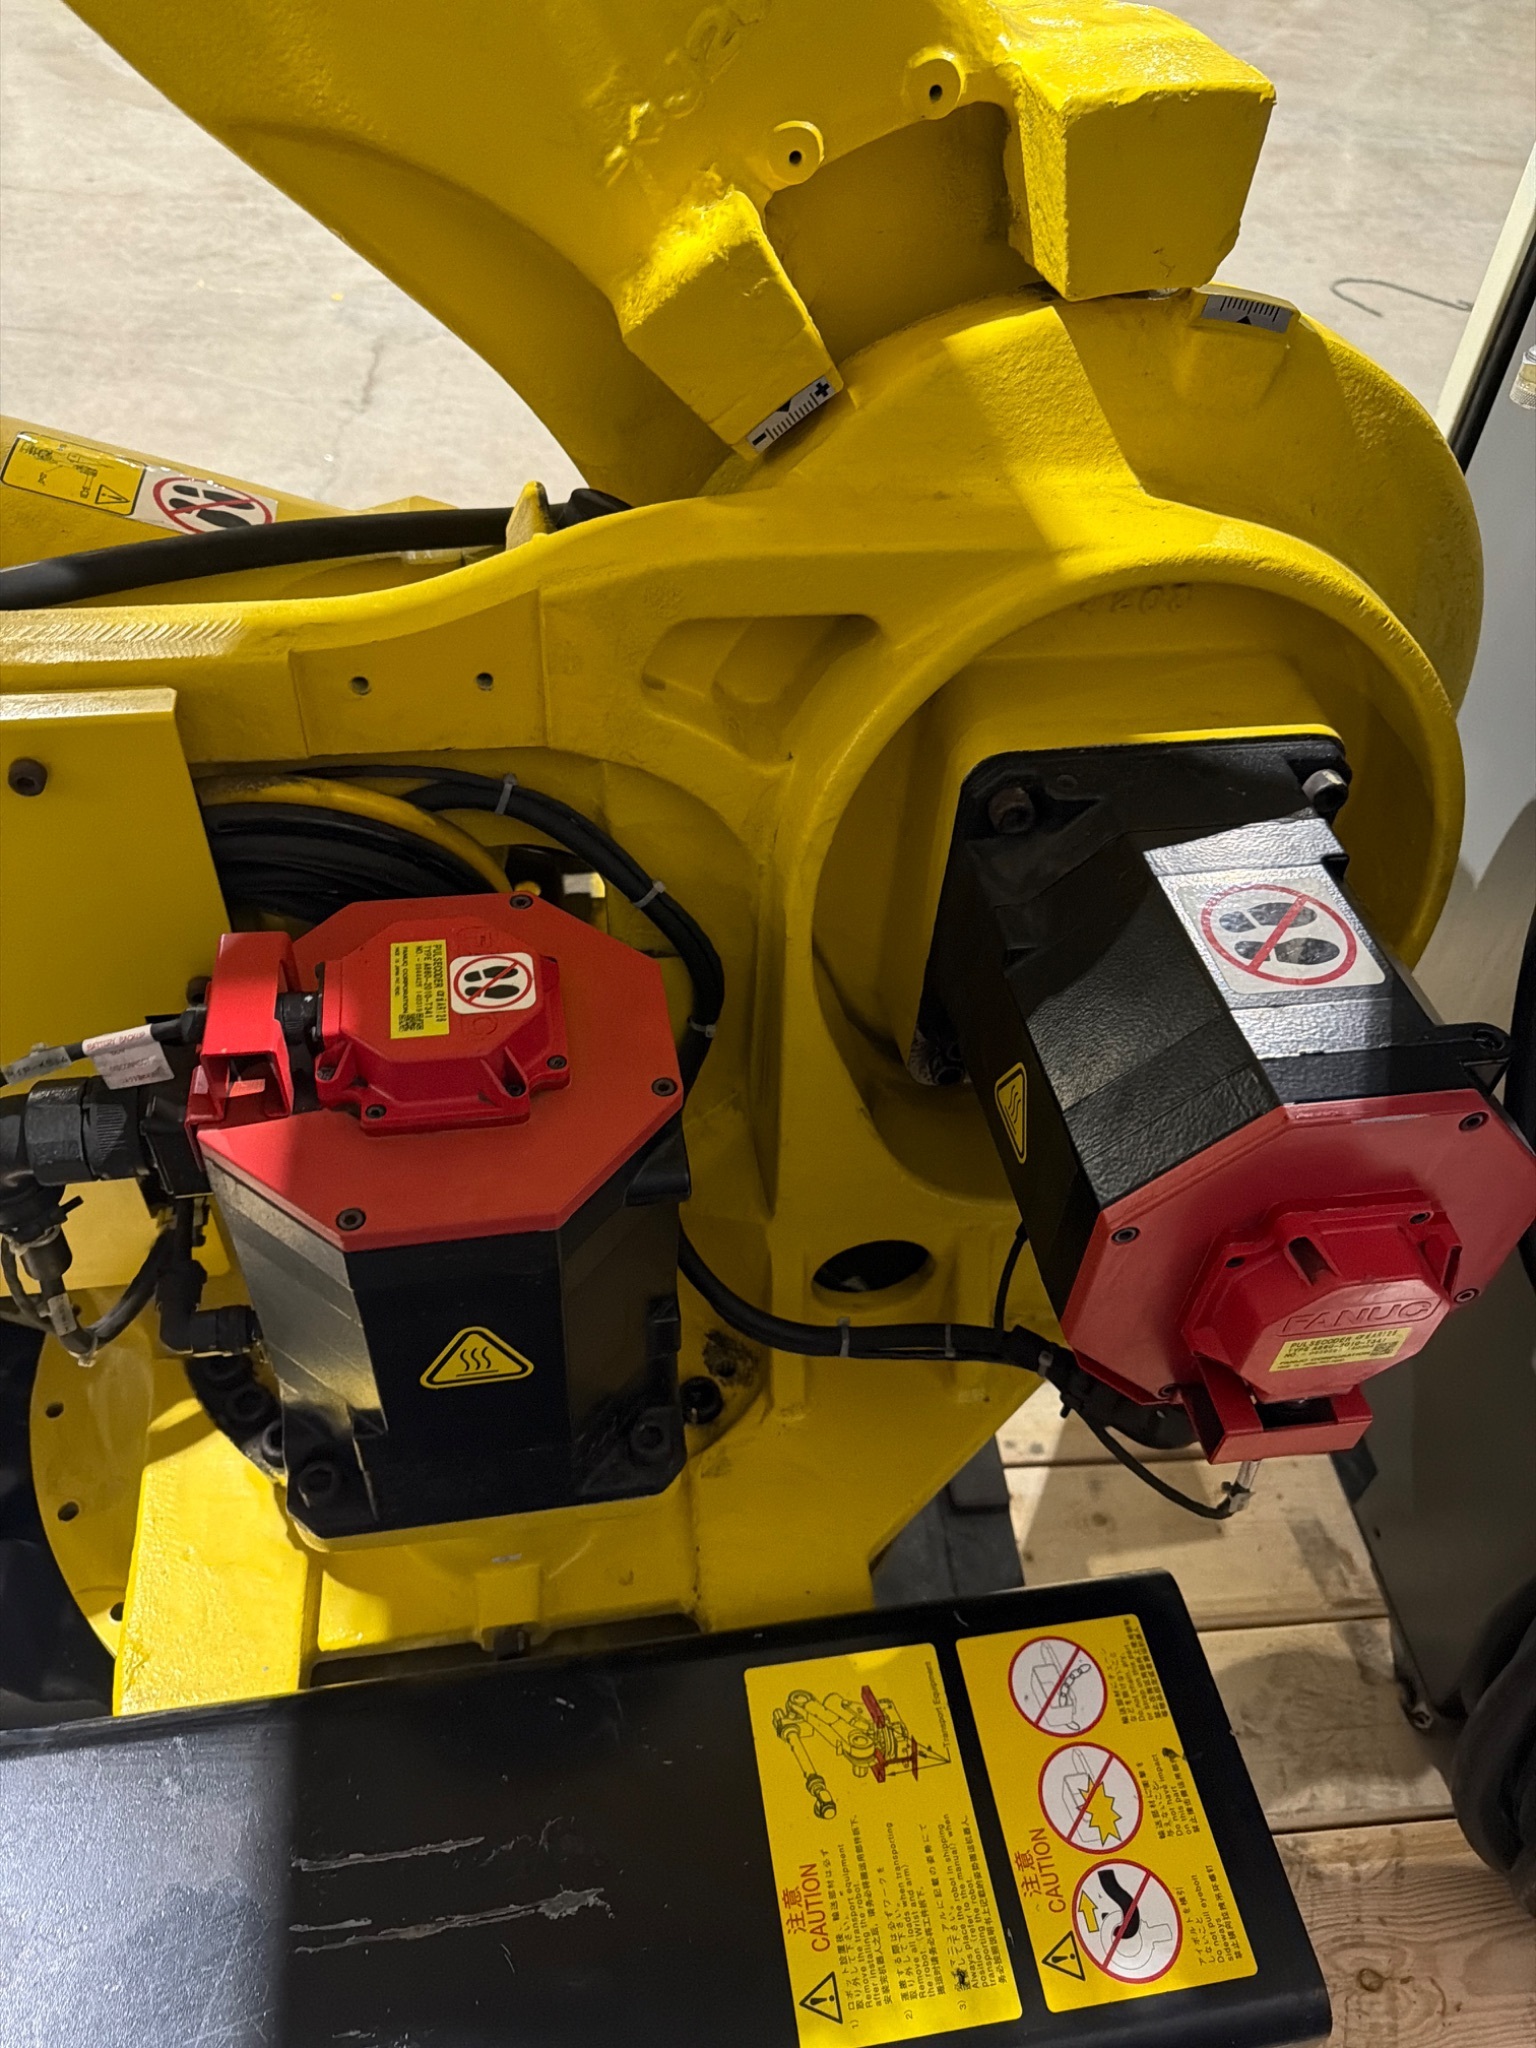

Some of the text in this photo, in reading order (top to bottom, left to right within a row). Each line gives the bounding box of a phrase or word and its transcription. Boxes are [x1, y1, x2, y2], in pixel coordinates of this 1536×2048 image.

[423, 945, 431, 960] TYPE
[432, 944, 443, 988] PULSECODER
[1281, 1300, 1432, 1332] FANUC
[1288, 1345, 1312, 1353] TYPE
[1289, 1336, 1351, 1348] PULSECODER
[924, 1660, 950, 1747] Transport Equipment
[1124, 1644, 1153, 1720] or strap on this part
[1132, 1695, 1140, 1708] not
[1136, 1710, 1144, 1721] Do
[1151, 1753, 1183, 1836] Do not have impact
[1170, 1786, 1191, 1834] on this part
[900, 1863, 912, 1886] arm)
[1013, 1849, 1041, 1898] 注意
[1028, 1828, 1067, 1913] CAUTION
[779, 1885, 808, 1934] 注意
[799, 1863, 831, 1952] CAUTION
[858, 1912, 867, 1927] the
[885, 1822, 926, 1998] Remove all loads when transporting
[907, 1889, 916, 1907] and
[936, 1823, 981, 1988] Always place the robot in shipping
[943, 1813, 990, 1987] position (refer to the manual) when
[972, 1907, 981, 1922] the
[1191, 1874, 1224, 1963] Do not pull eyebolt
[837, 1843, 873, 2008] Remove the transport equipment
[911, 1910, 924, 1940] (Wrist
[1194, 1916, 1215, 1962] しないこと
[1214, 1917, 1233, 1961] sideways
[841, 1915, 864, 2009] 取り外して下さい。
[861, 1931, 877, 1978] installing
[891, 1902, 917, 1999] 取り外して下さい。
[976, 1925, 997, 1986] transporting
[871, 1981, 882, 2006] after
[925, 1980, 935, 1997] the
